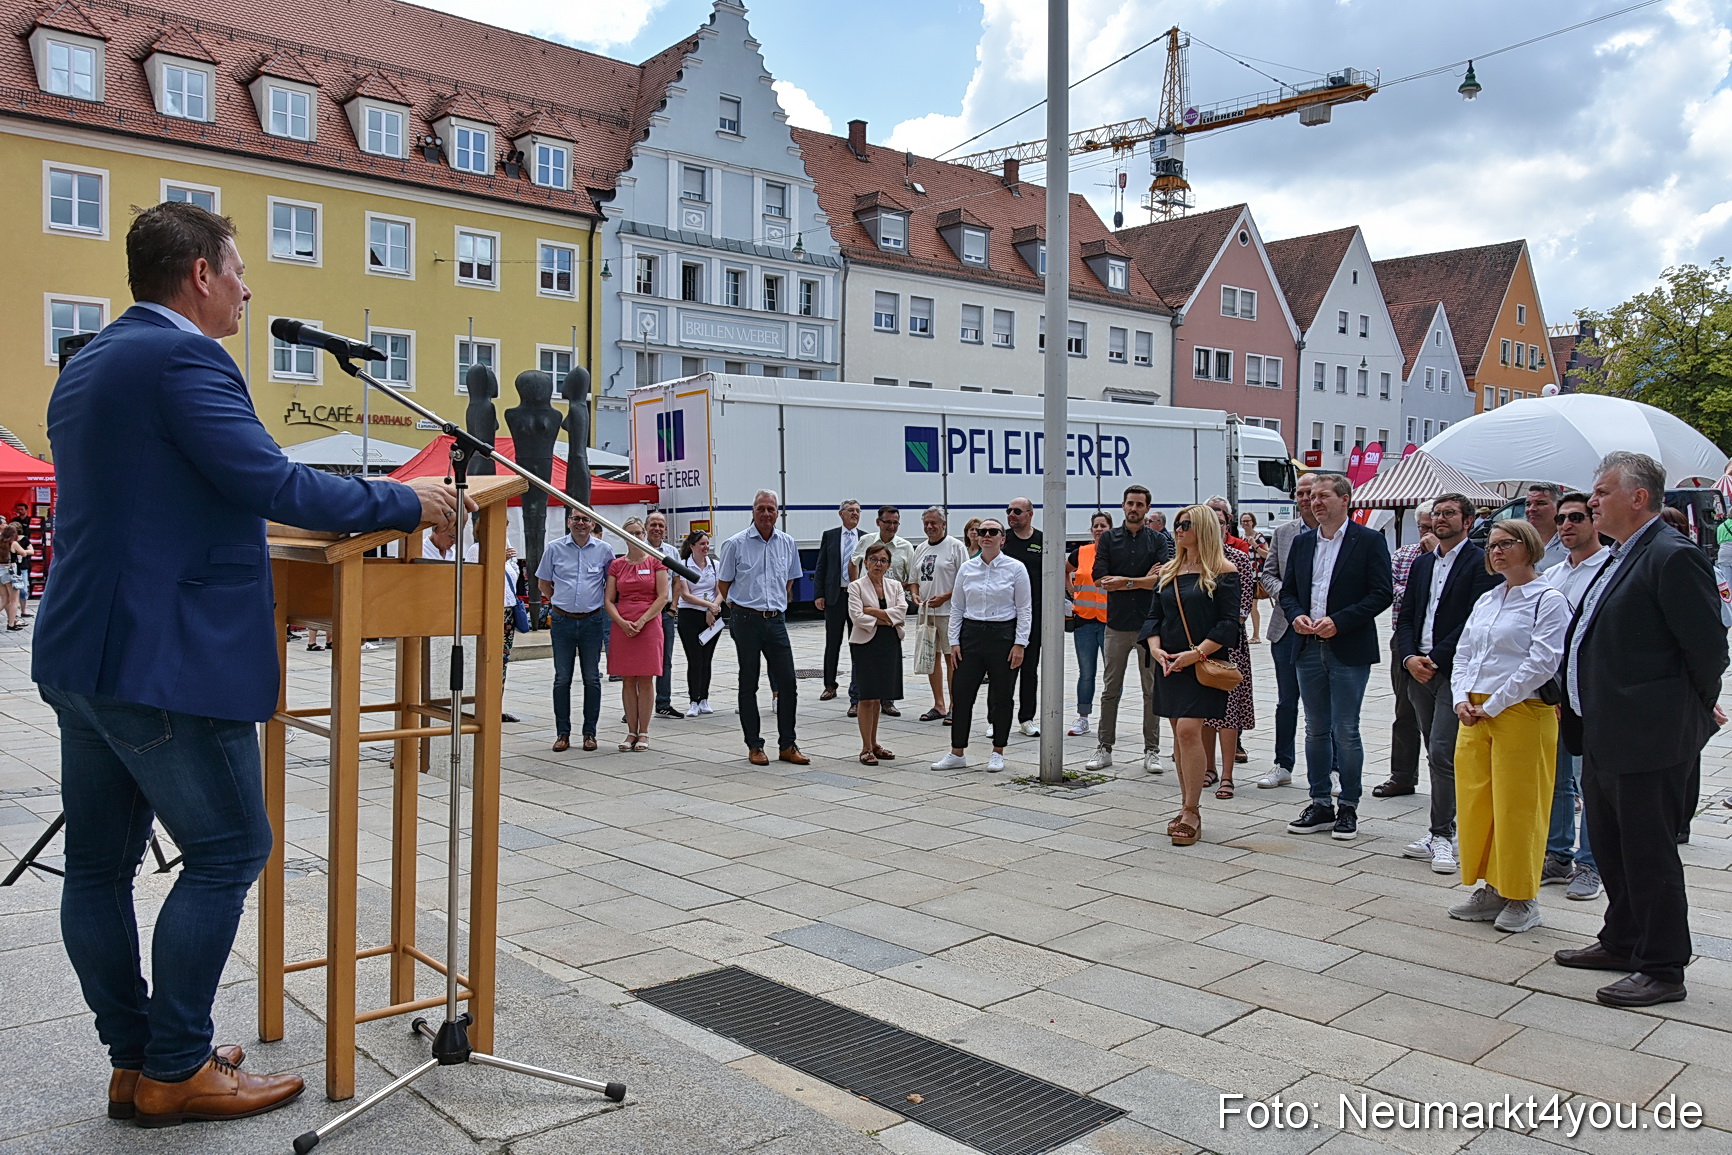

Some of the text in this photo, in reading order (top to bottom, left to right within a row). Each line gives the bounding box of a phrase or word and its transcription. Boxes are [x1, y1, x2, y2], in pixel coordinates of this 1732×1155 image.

[1202, 110, 1244, 124] LIEBHERR
[685, 321, 780, 345] BRILLEN WEBER
[313, 404, 354, 423] CAFÉ
[374, 414, 413, 426] RATHAUS
